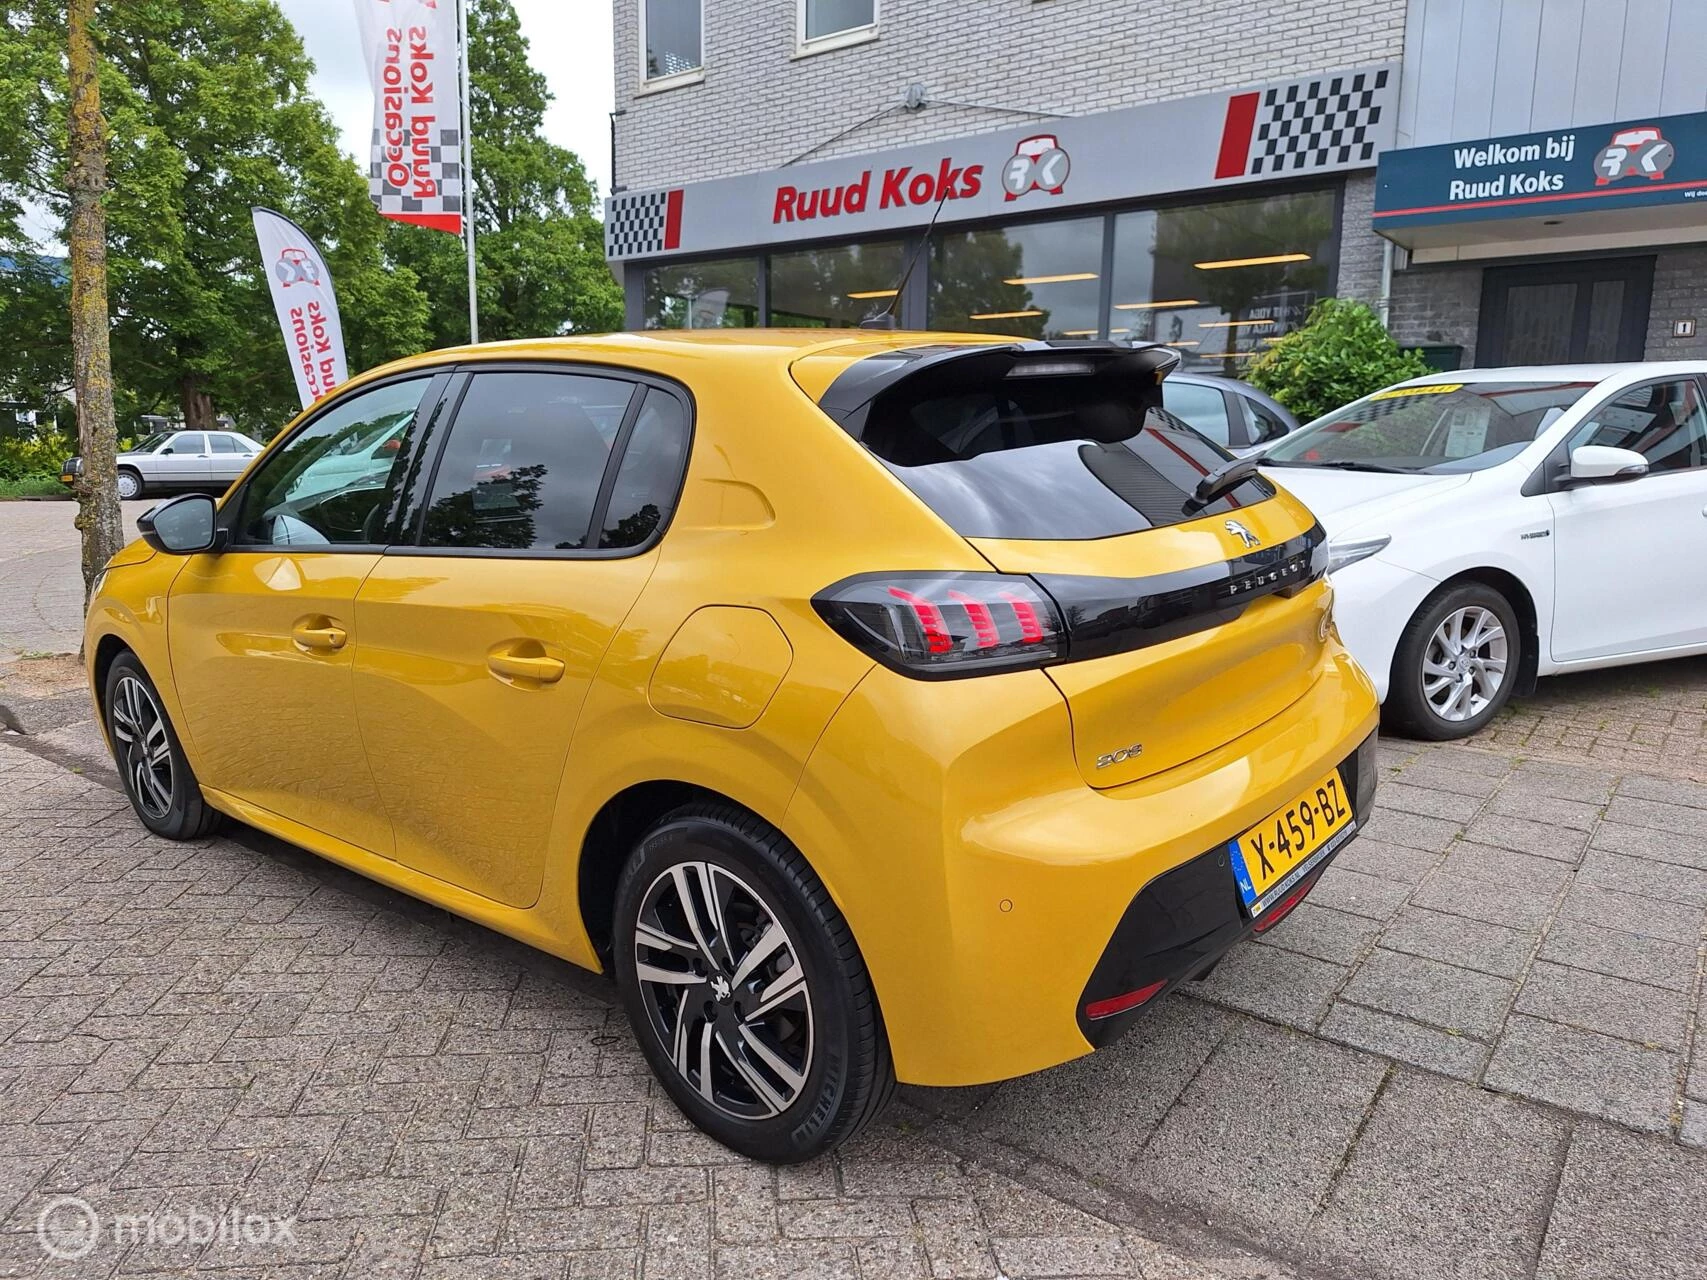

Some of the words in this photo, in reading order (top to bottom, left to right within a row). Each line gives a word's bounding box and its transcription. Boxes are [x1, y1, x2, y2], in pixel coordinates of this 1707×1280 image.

[1453, 143, 1541, 169] Welkom
[1544, 134, 1576, 162] bij
[773, 170, 872, 224] Ruud
[879, 157, 984, 209] Koks
[1449, 173, 1505, 201] Ruud
[1509, 169, 1565, 195] Koks
[1229, 559, 1306, 595] PEUGEOT
[1096, 743, 1143, 769] 208
[1250, 778, 1346, 880] X-459-BZ
[1239, 878, 1252, 894] NL
